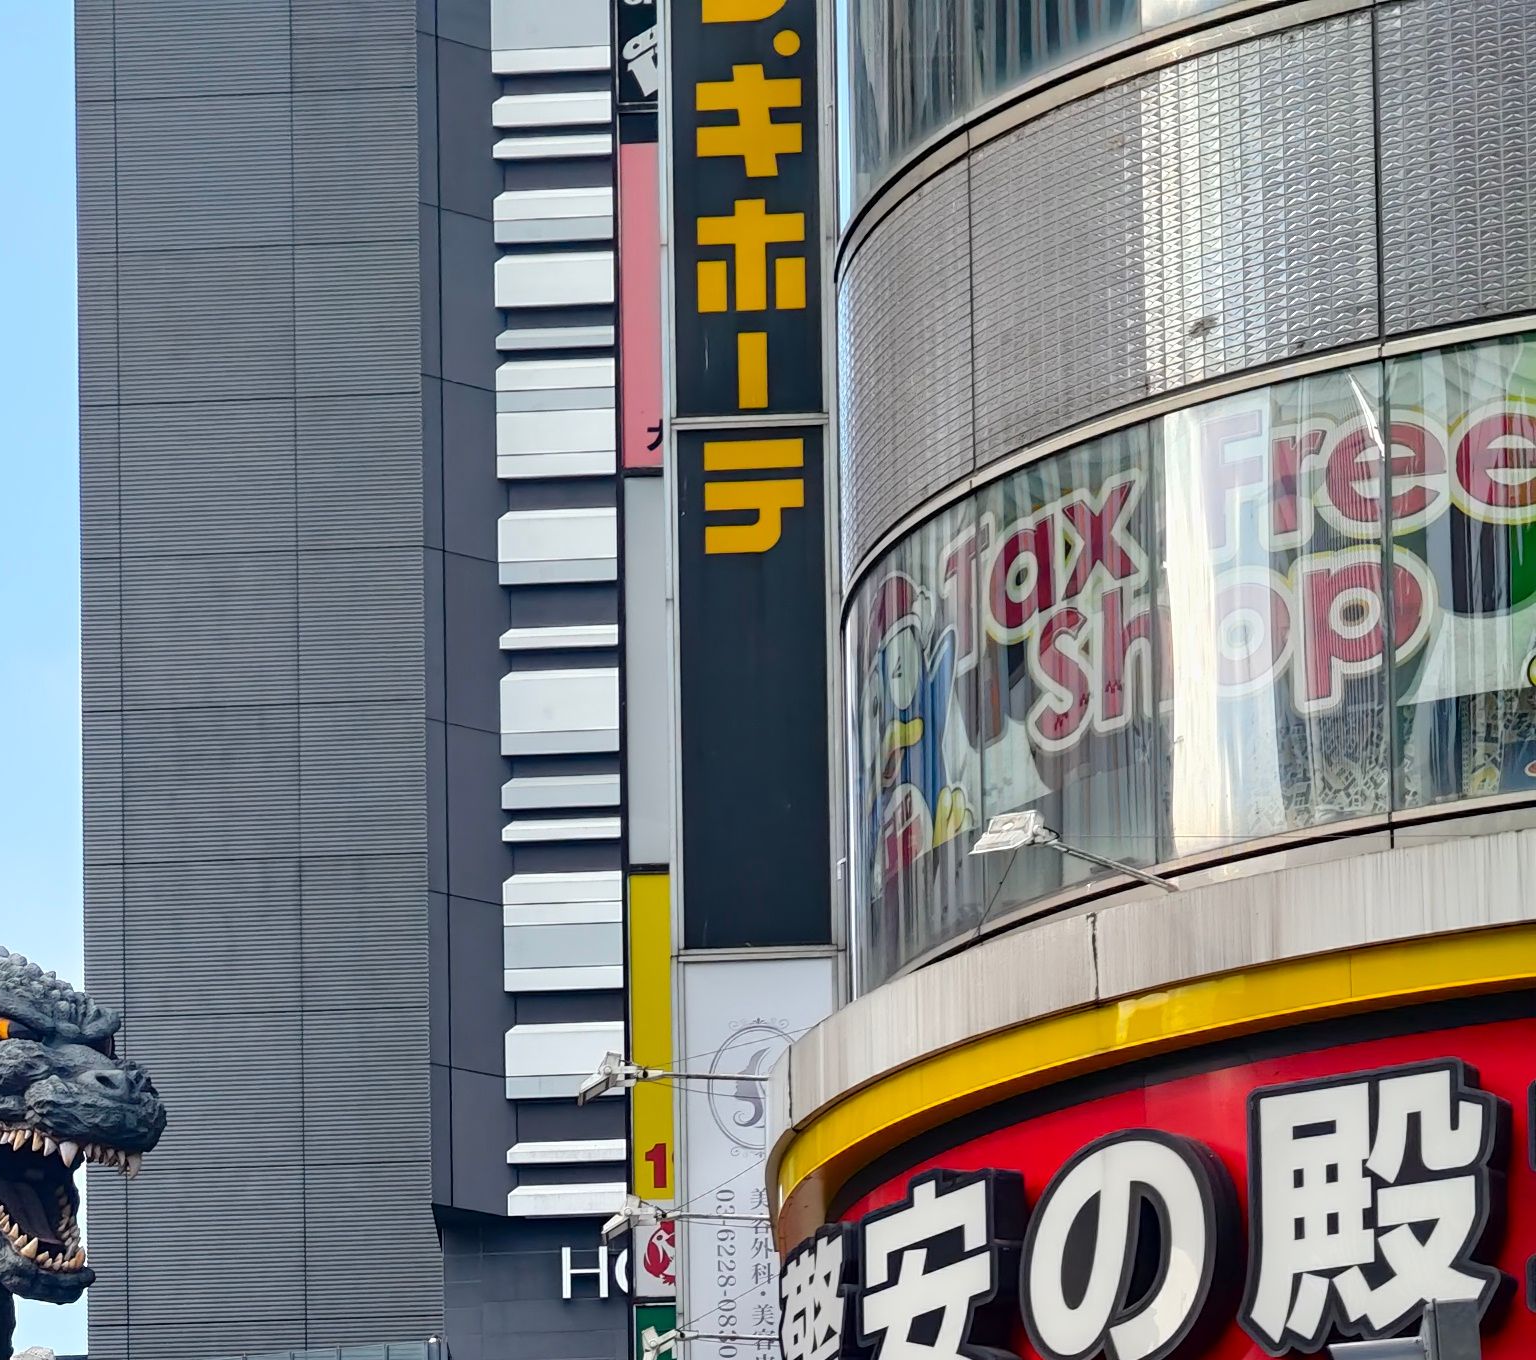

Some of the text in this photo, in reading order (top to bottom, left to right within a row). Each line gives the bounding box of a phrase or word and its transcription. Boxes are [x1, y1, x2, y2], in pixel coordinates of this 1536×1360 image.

[696, 0, 806, 555] ・キホーテ
[942, 463, 1156, 680] Tax
[1194, 400, 1536, 560] Free
[1026, 543, 1441, 758] Shop
